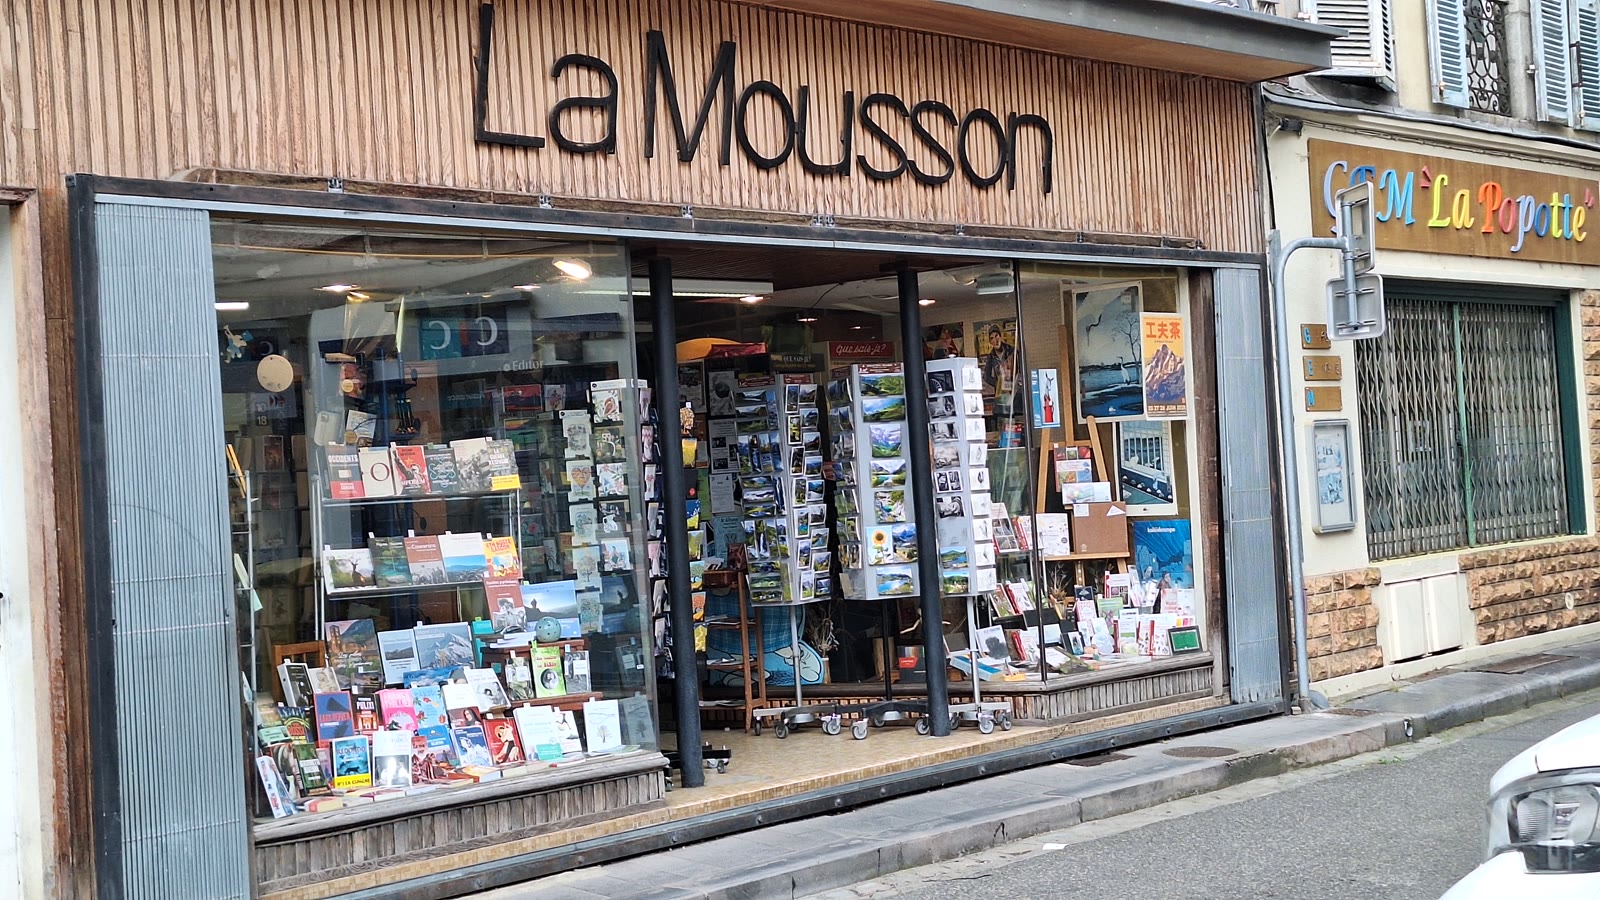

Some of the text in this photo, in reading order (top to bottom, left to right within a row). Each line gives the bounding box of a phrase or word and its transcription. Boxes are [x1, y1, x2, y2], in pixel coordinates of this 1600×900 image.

[475, 3, 1053, 193] La Mousson
[1478, 181, 1587, 252] Popotte
[1145, 321, 1181, 340] 工夫茶
[836, 343, 854, 355] Que
[328, 454, 358, 463] OCCIDENTS
